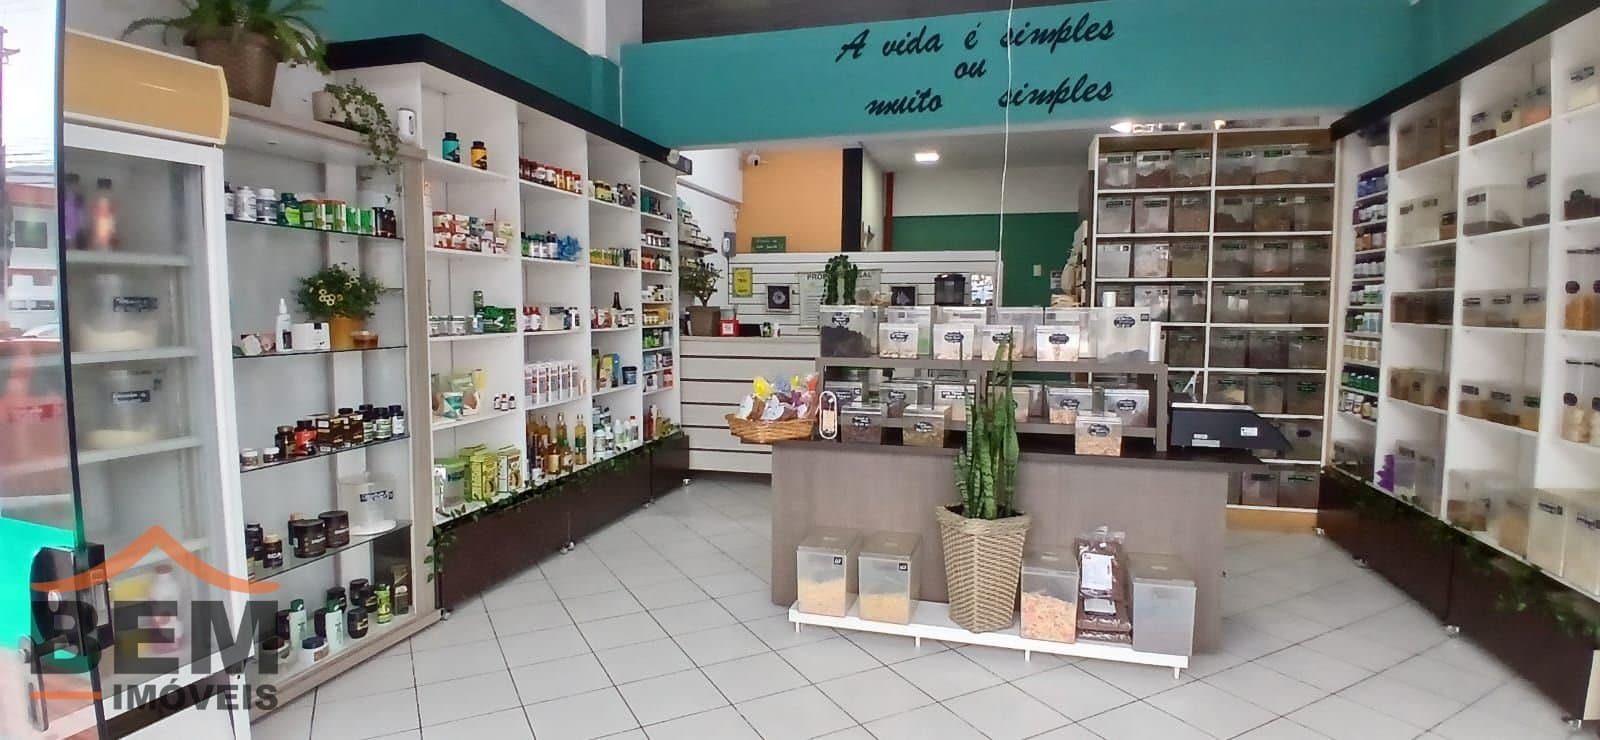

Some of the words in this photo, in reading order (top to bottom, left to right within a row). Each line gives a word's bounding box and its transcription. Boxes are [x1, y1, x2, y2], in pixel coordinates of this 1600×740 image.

[835, 29, 870, 62] A
[882, 25, 944, 57] vida
[963, 22, 982, 50] é
[999, 12, 1115, 53] simples
[954, 58, 987, 79] ou
[864, 87, 944, 116] muito
[998, 73, 1114, 114] simples
